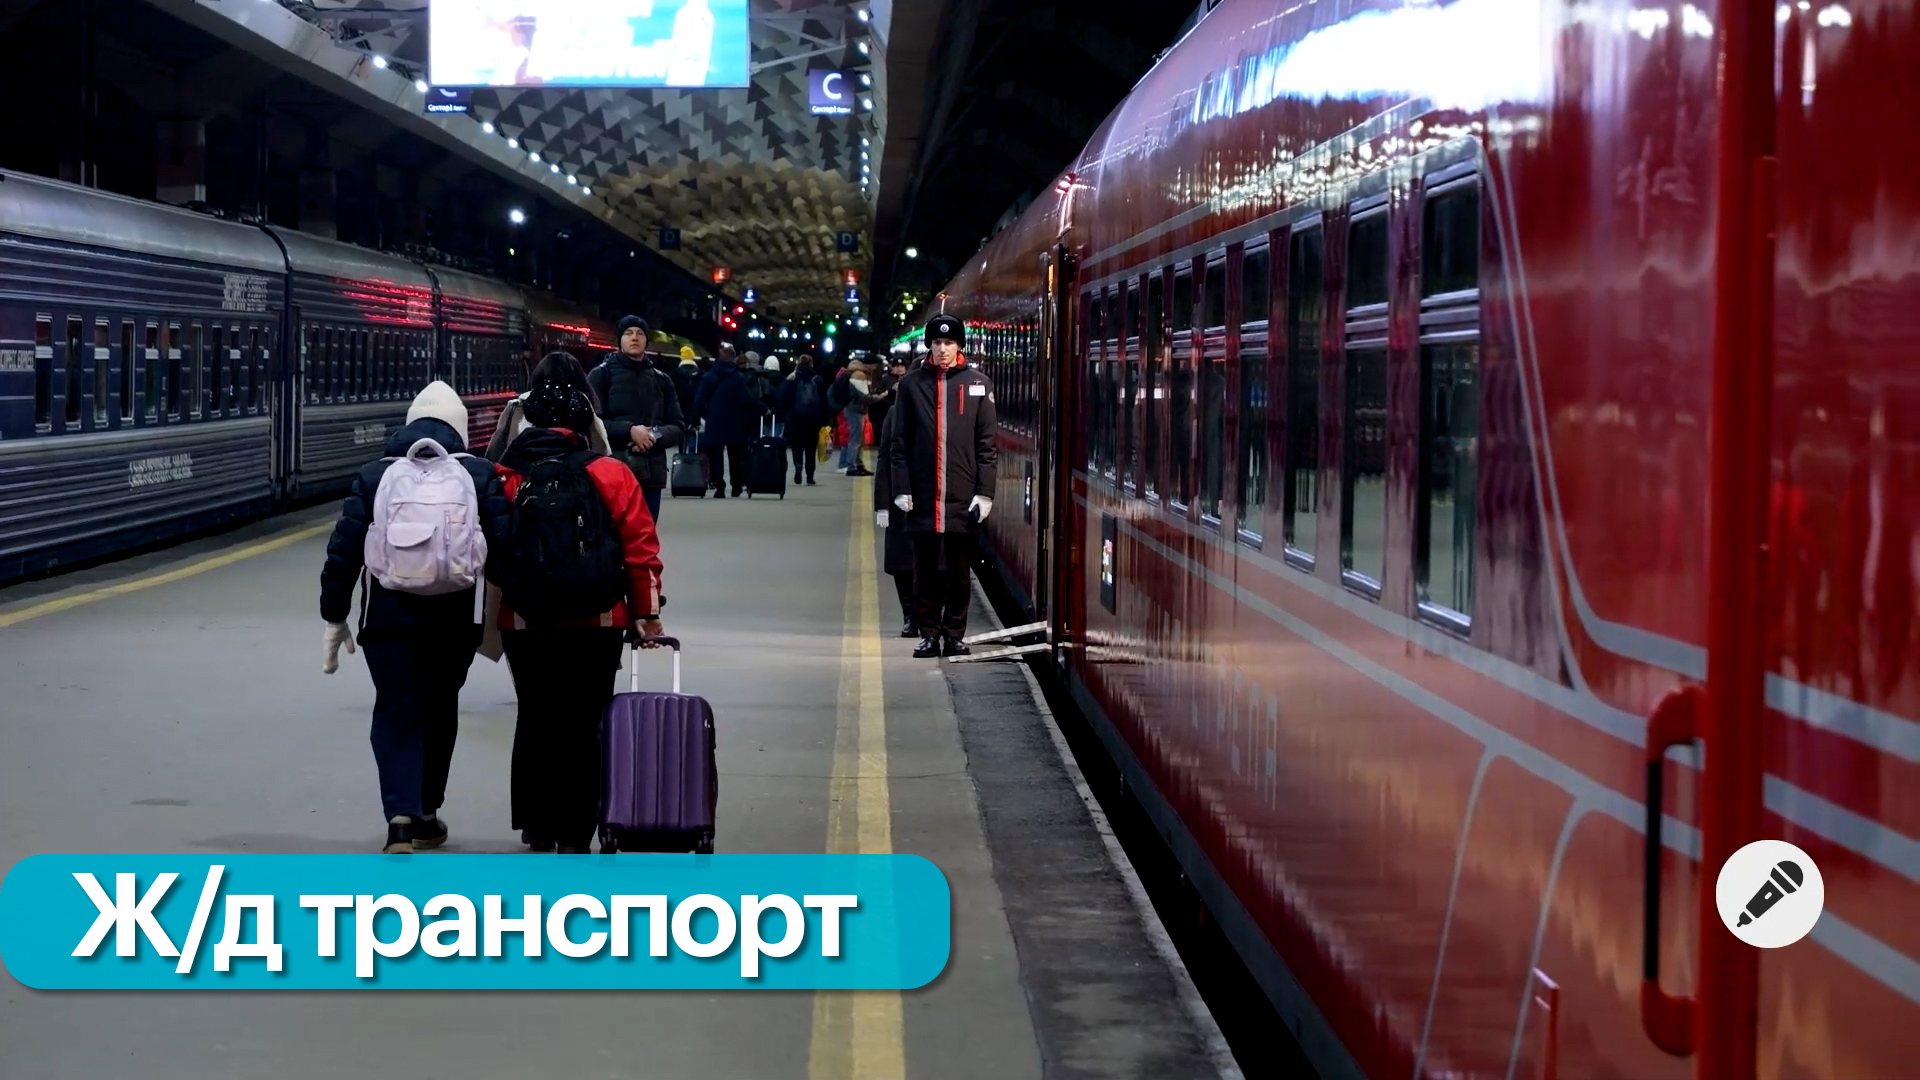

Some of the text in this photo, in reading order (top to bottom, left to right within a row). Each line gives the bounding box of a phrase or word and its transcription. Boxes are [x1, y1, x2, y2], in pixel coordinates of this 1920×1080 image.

[822, 72, 842, 100] C
[664, 230, 675, 243] D
[841, 232, 853, 246] D
